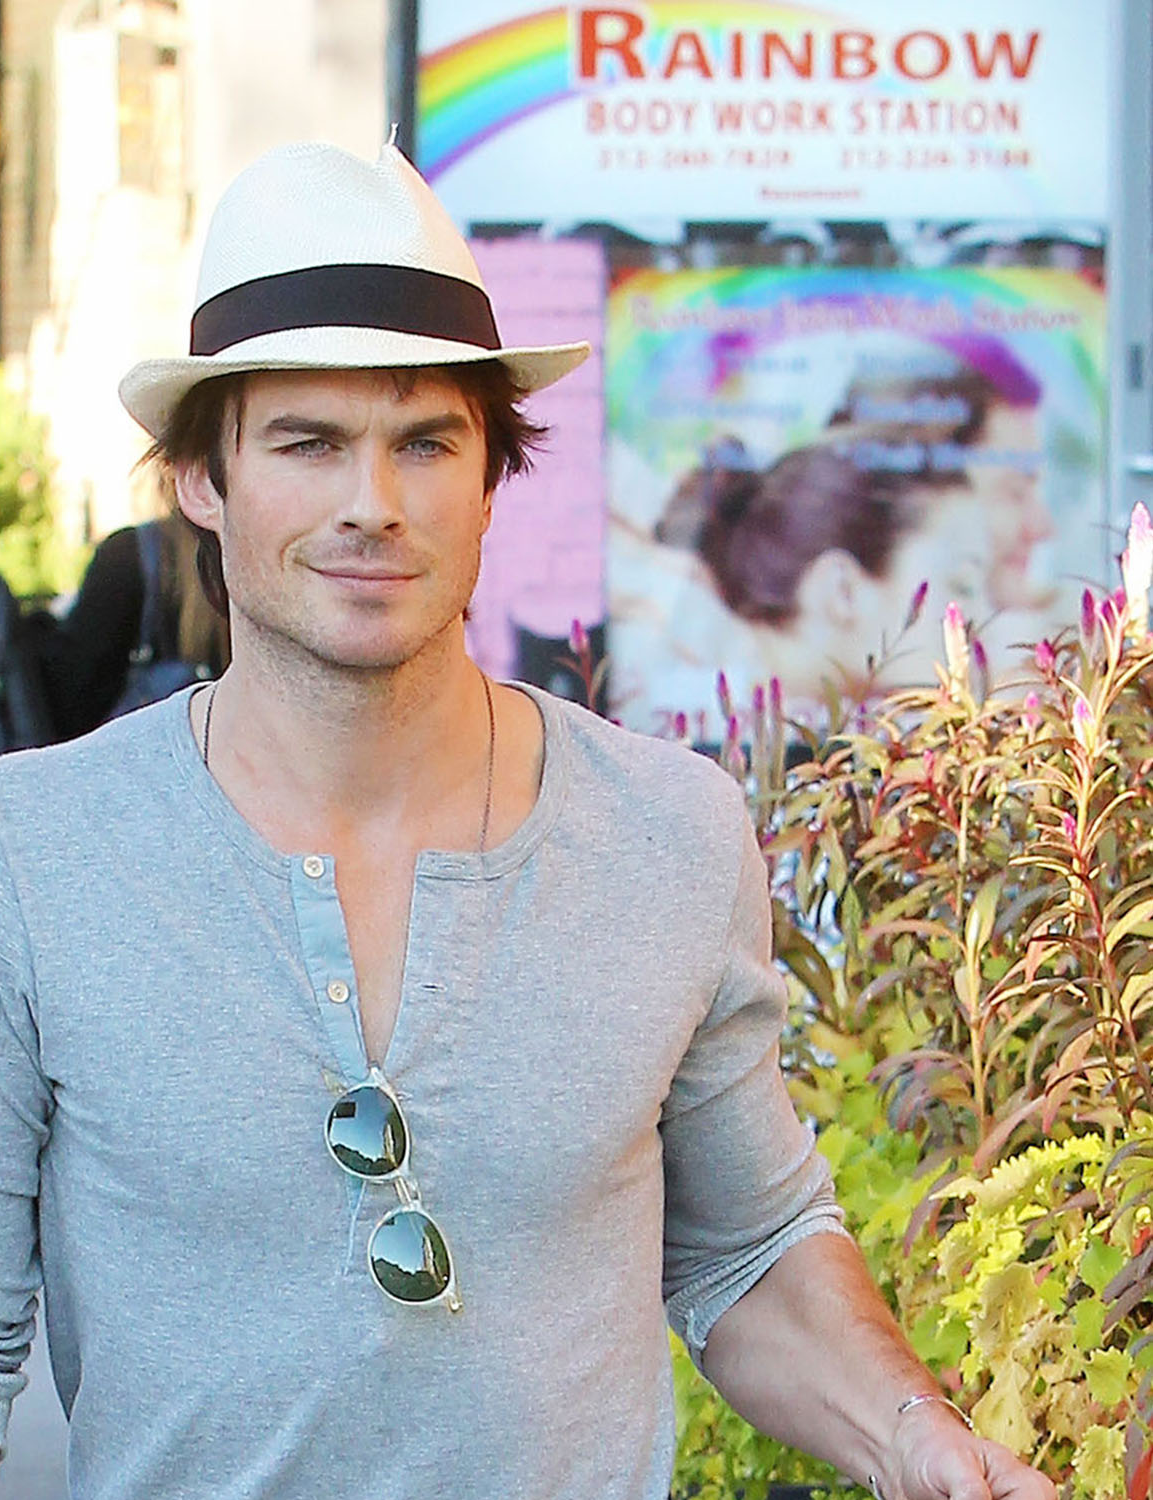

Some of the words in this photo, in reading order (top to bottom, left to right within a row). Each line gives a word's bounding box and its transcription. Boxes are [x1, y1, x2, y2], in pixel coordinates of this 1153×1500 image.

[578, 7, 1040, 81] RAINBOW
[586, 99, 698, 134] BODY
[712, 99, 830, 134] WORK
[849, 99, 1020, 134] STATION
